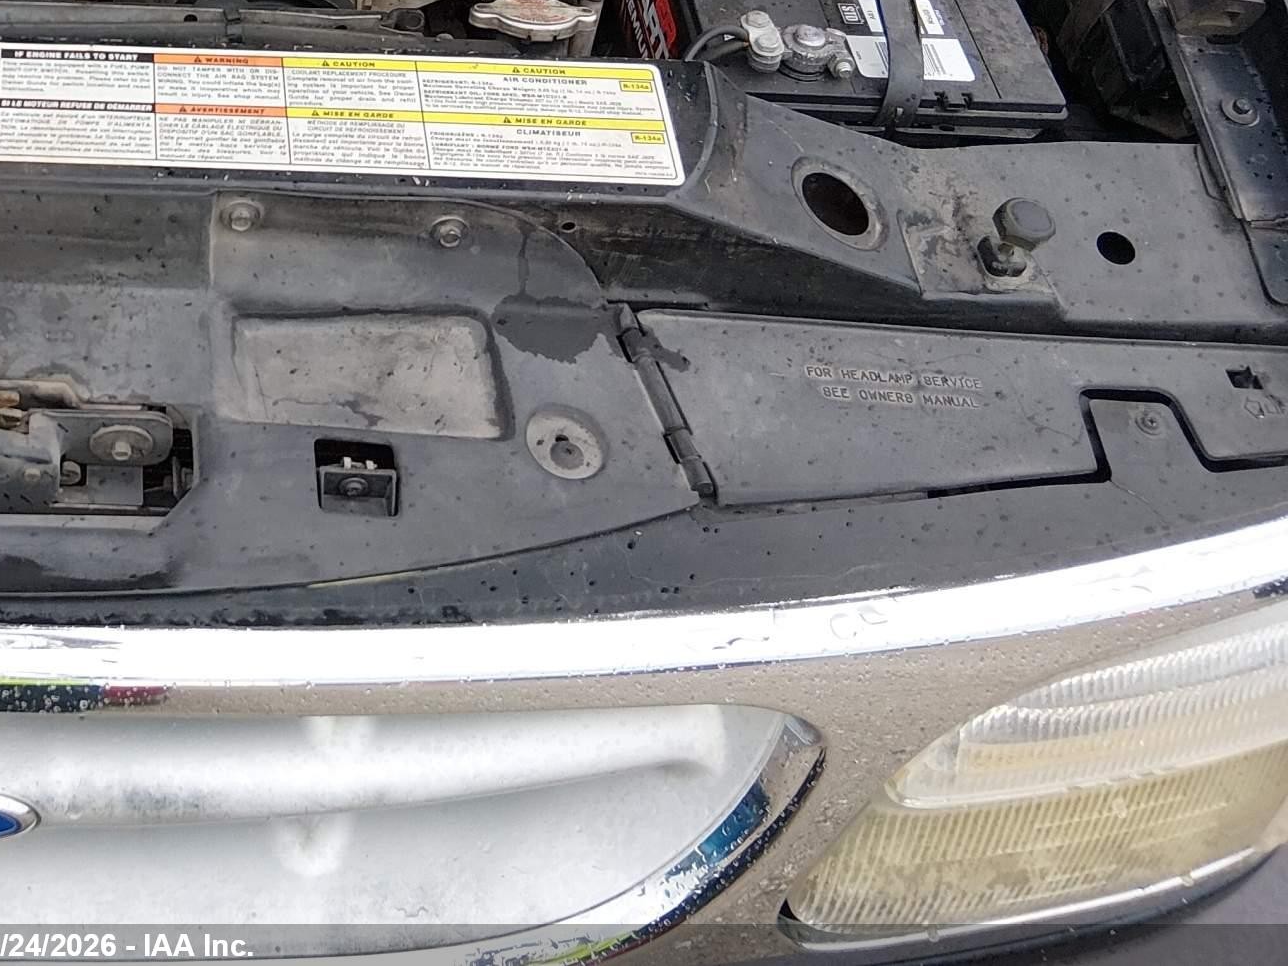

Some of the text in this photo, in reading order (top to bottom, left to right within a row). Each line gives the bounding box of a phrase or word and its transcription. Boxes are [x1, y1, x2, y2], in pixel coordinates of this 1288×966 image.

[806, 366, 983, 389] FOR HEADLAMP SERVICE
[823, 386, 980, 408] SEE OWNERS MANUAL
